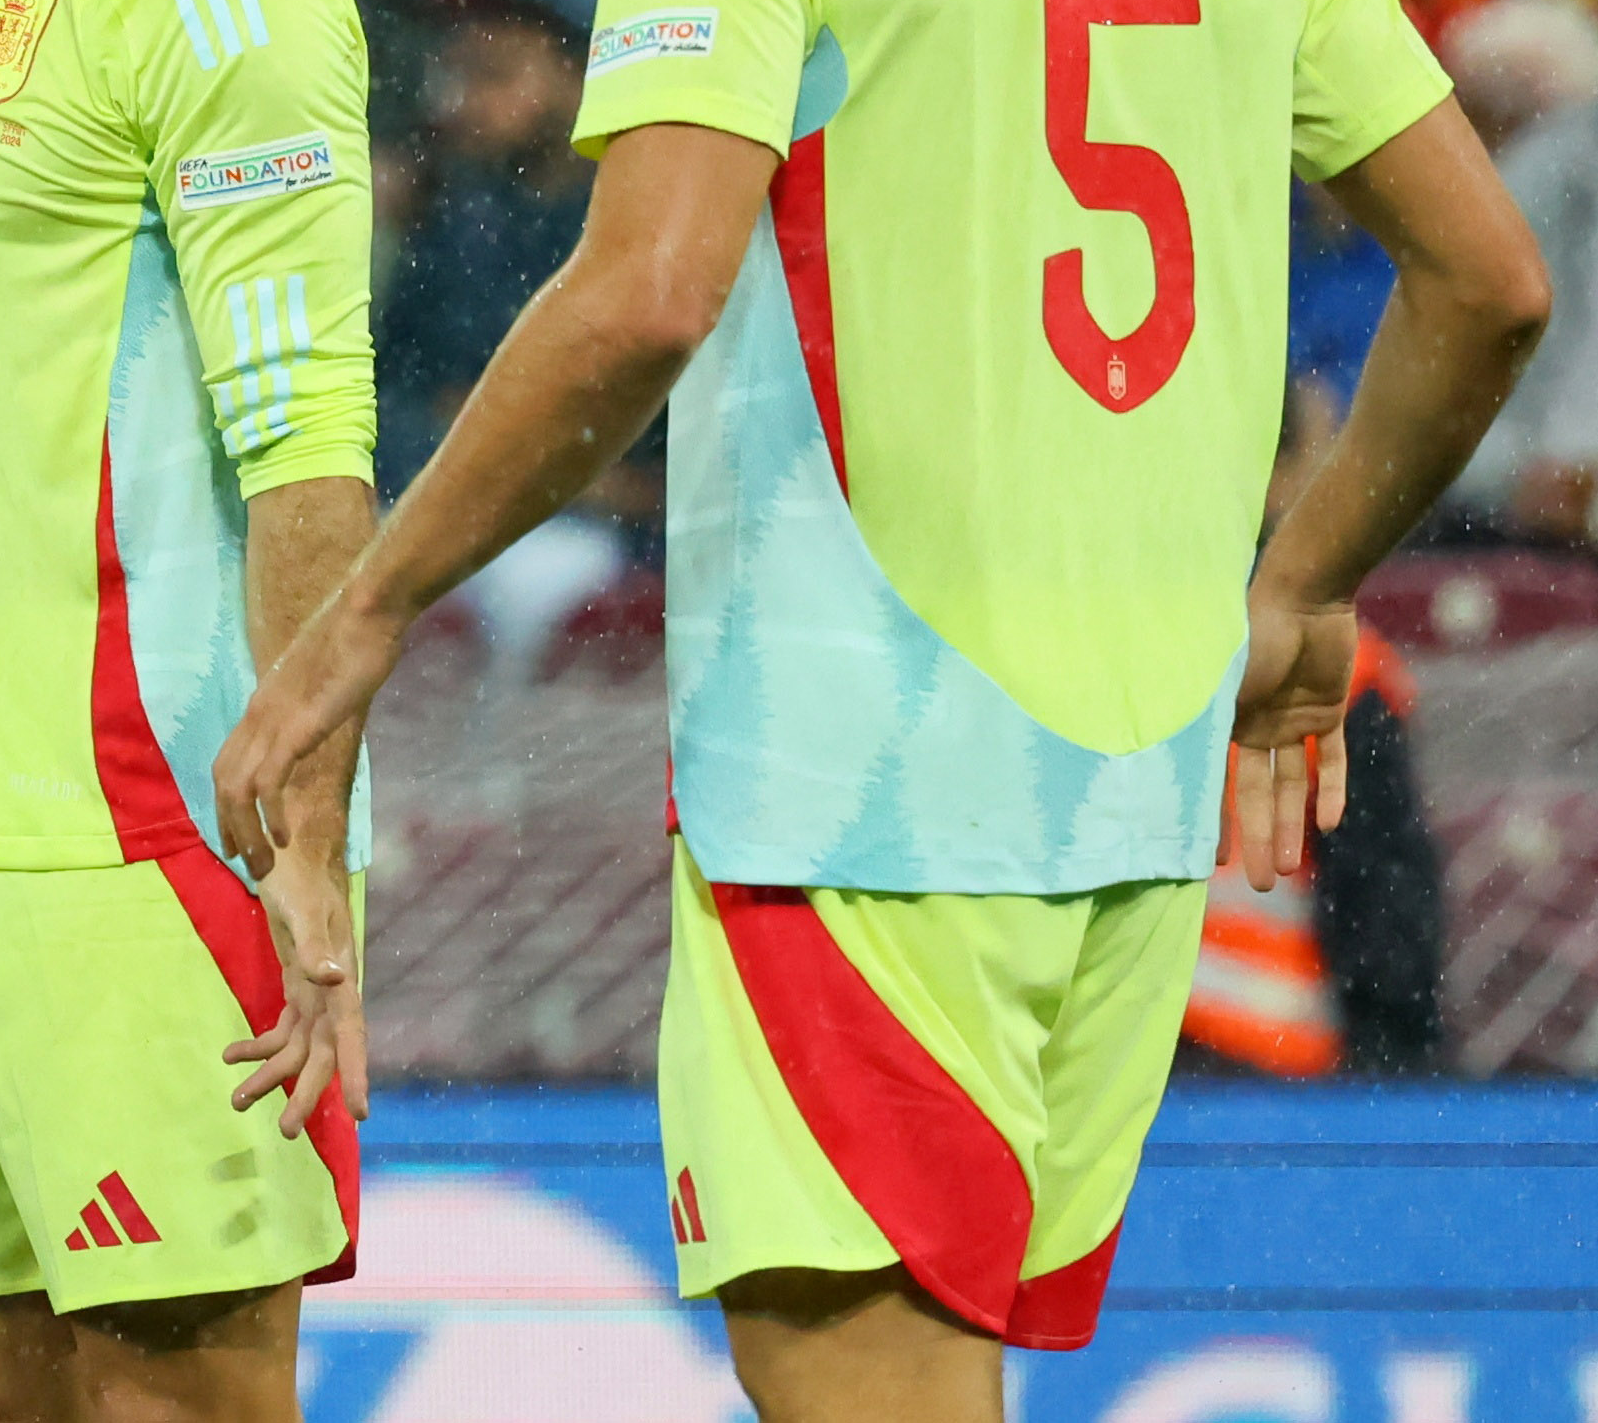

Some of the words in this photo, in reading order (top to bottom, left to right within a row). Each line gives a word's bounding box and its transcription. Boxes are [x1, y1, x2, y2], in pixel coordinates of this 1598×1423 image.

[0, 133, 21, 147] 2024
[179, 158, 209, 173] UEFA
[180, 147, 330, 192] FOUNDATION
